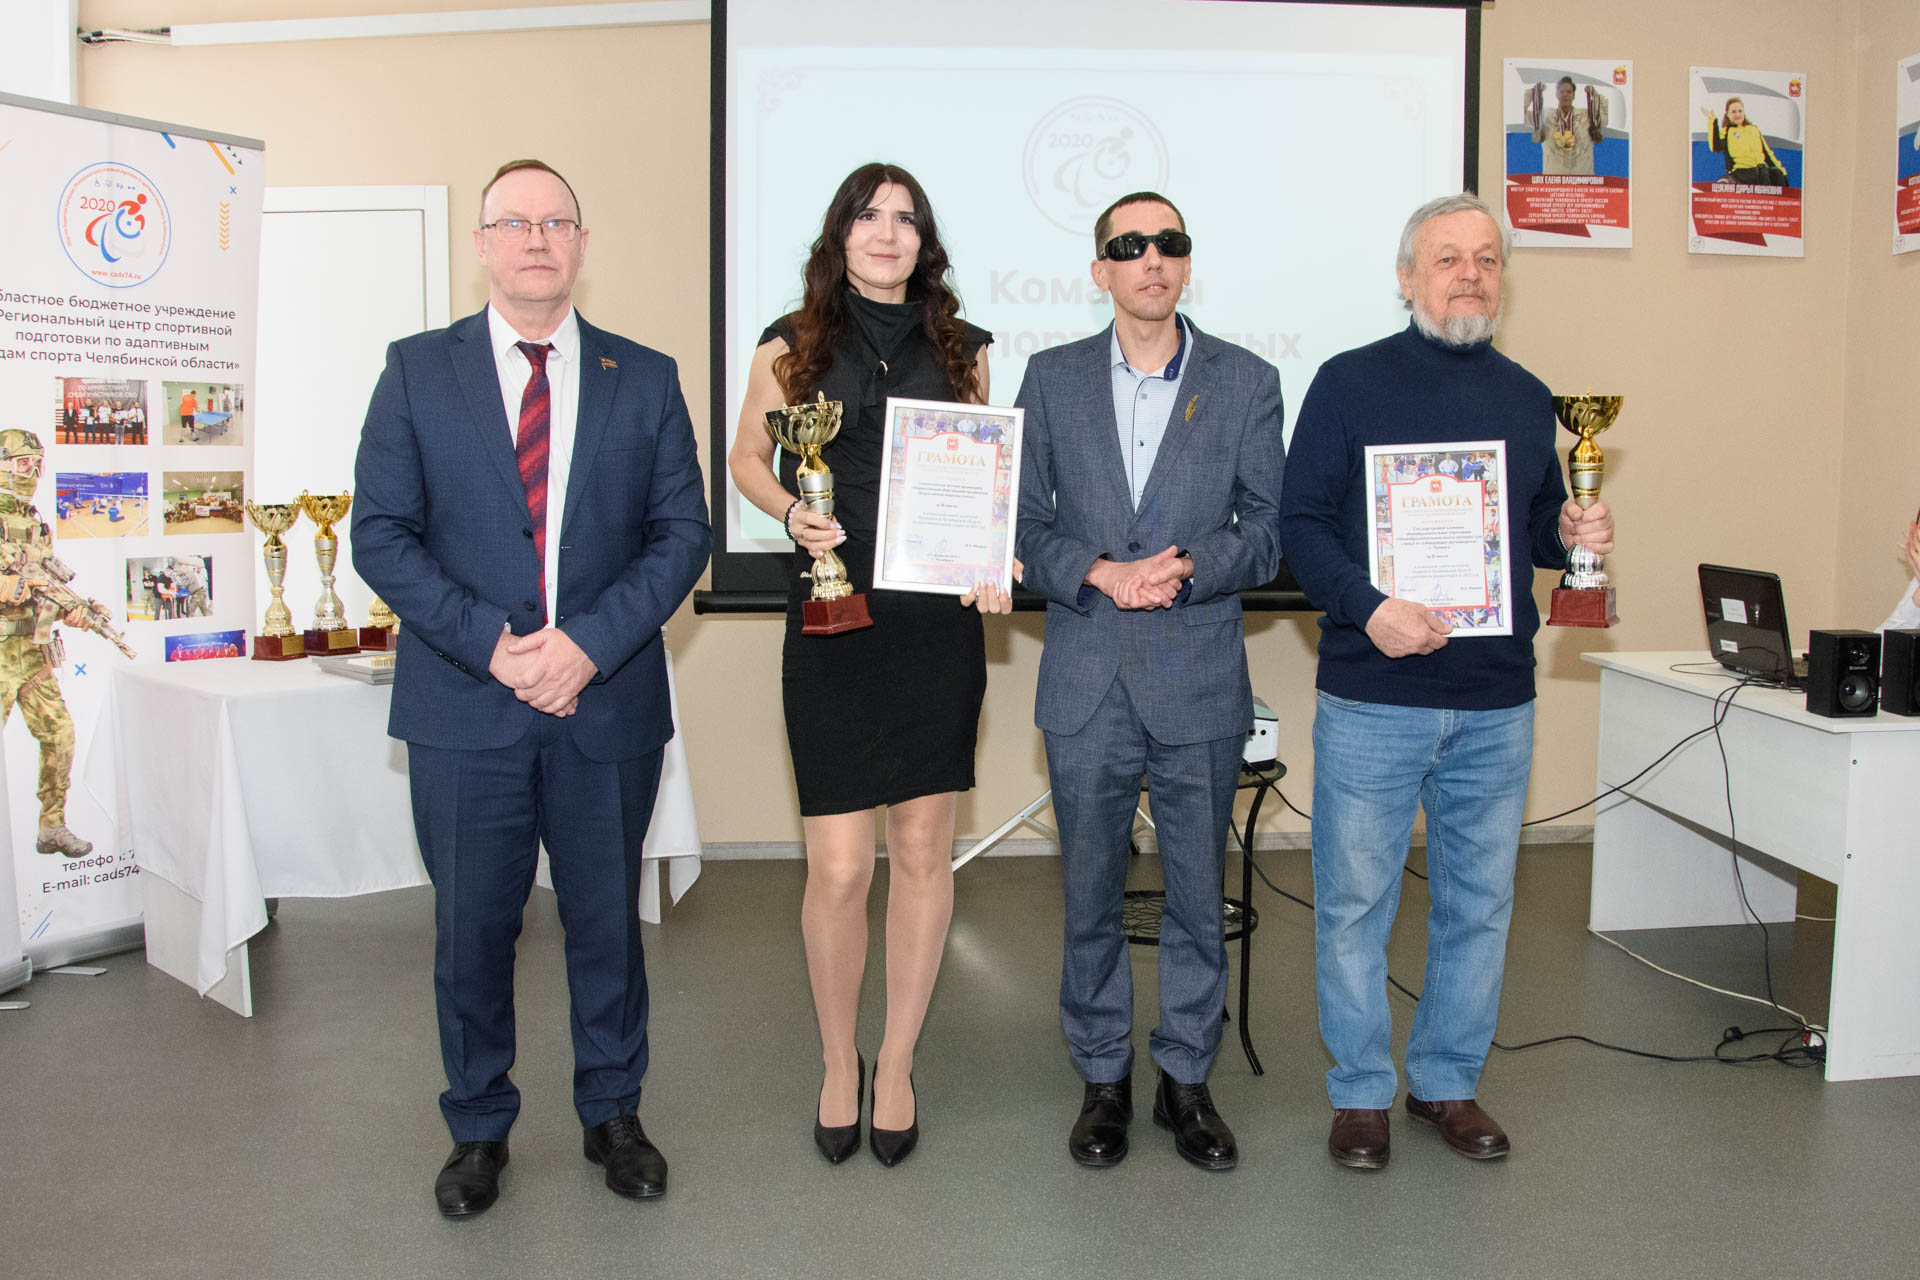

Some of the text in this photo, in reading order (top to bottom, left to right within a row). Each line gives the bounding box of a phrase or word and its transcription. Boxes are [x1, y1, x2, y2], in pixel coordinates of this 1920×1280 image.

[1048, 133, 1093, 149] 2020
[80, 196, 116, 212] 2020
[990, 270, 1204, 305] Комаы
[69, 295, 151, 313] бюджетное
[154, 305, 236, 320] учреждение
[109, 319, 151, 333] центр
[154, 322, 232, 336] спортивной
[15, 331, 210, 352] подготовки по адаптивным
[30, 351, 82, 364] спорта
[86, 352, 178, 367] Челябинской
[181, 356, 240, 370] области»
[917, 452, 987, 467] ГРАМОТА
[1401, 495, 1472, 508] ГРАМОТА
[42, 864, 141, 894] E-mail: cads74
